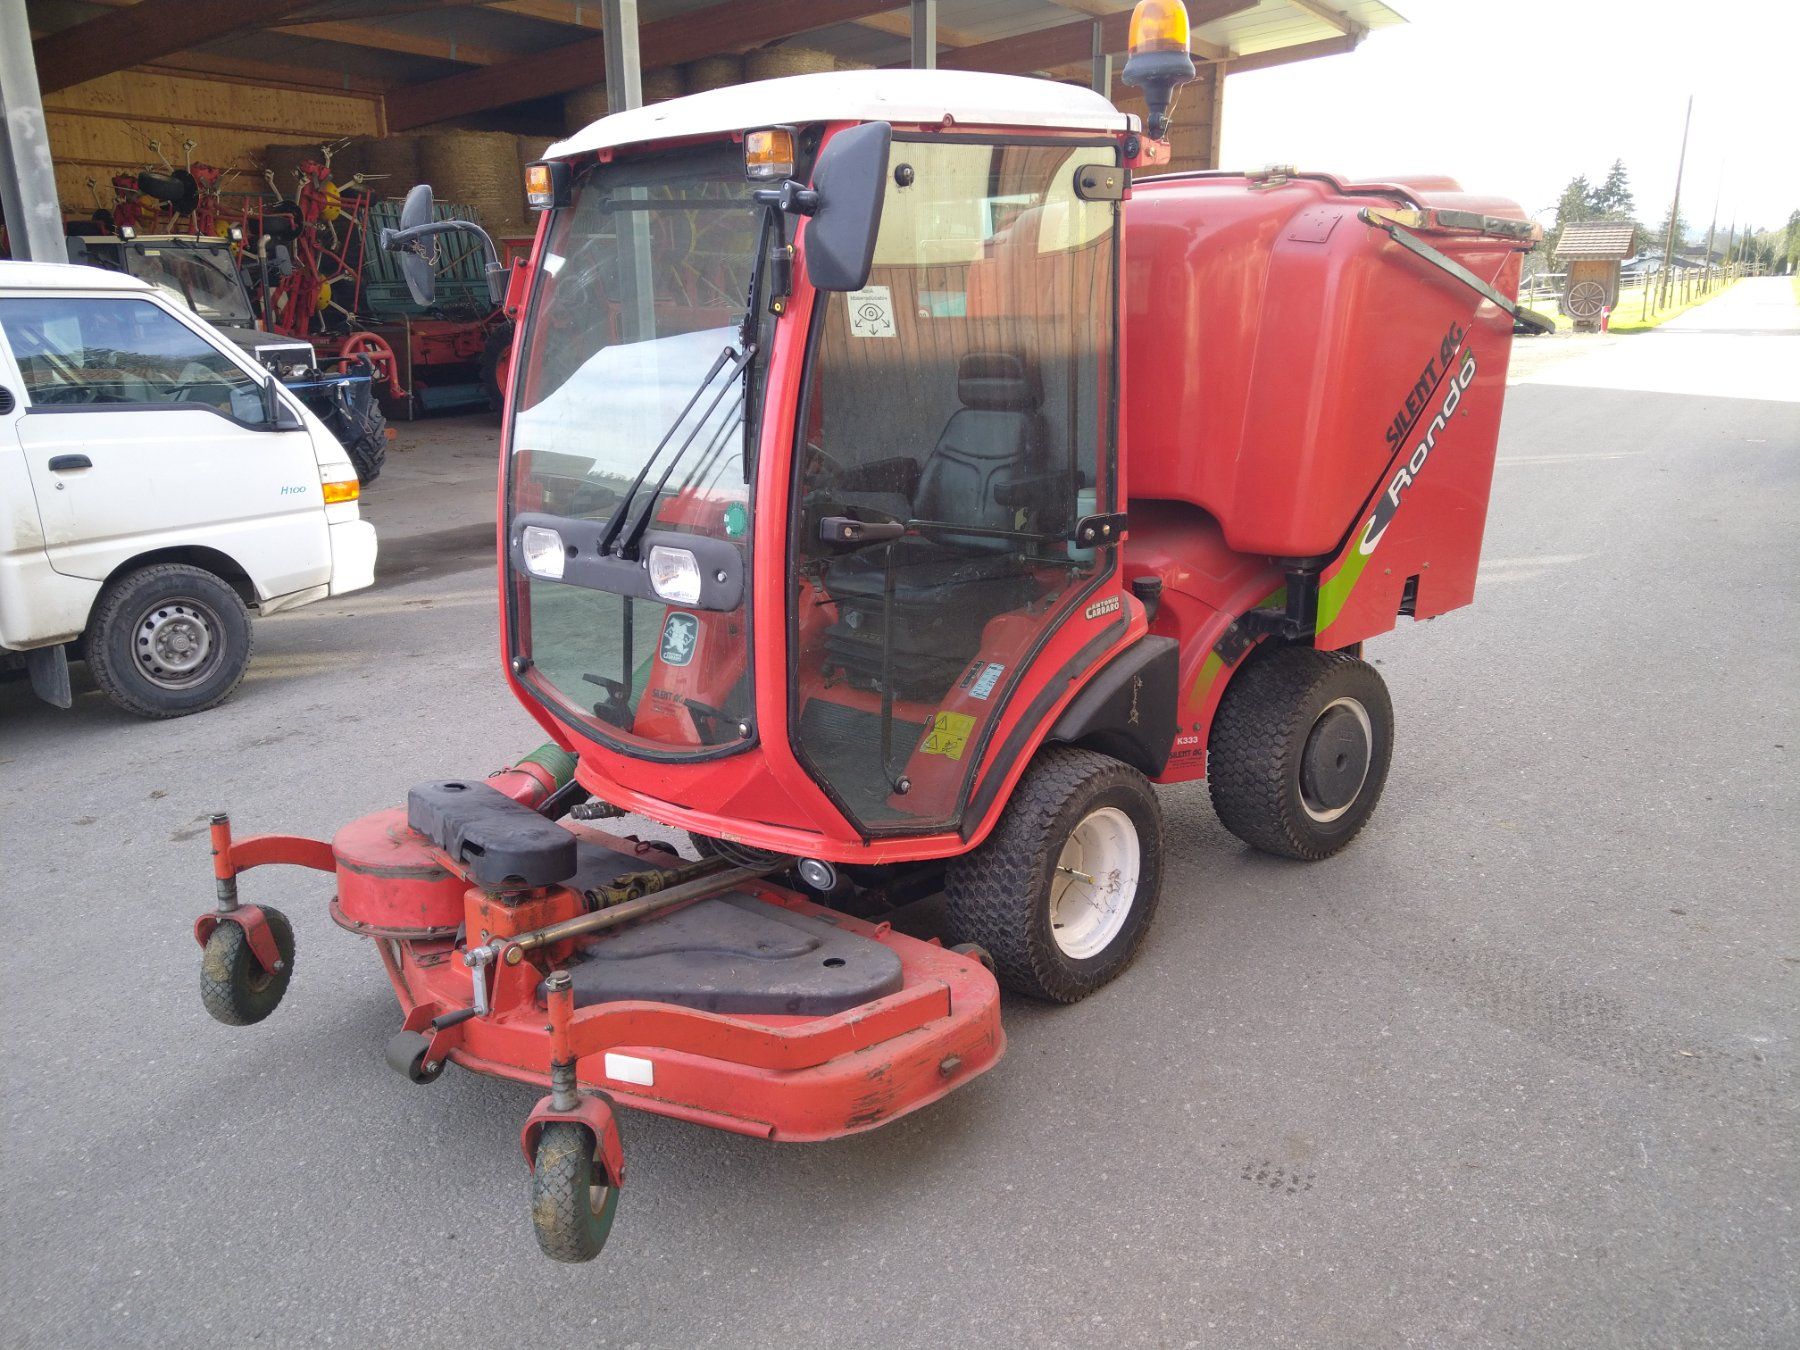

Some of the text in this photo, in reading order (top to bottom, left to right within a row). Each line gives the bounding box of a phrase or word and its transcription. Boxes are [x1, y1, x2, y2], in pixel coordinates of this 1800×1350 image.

[1386, 321, 1463, 451] SILENT AG
[1387, 357, 1476, 507] Rondo
[280, 485, 307, 496] H100
[1085, 602, 1120, 620] CARRARO
[1090, 596, 1119, 610] ANTONIO
[1177, 736, 1199, 745] K333
